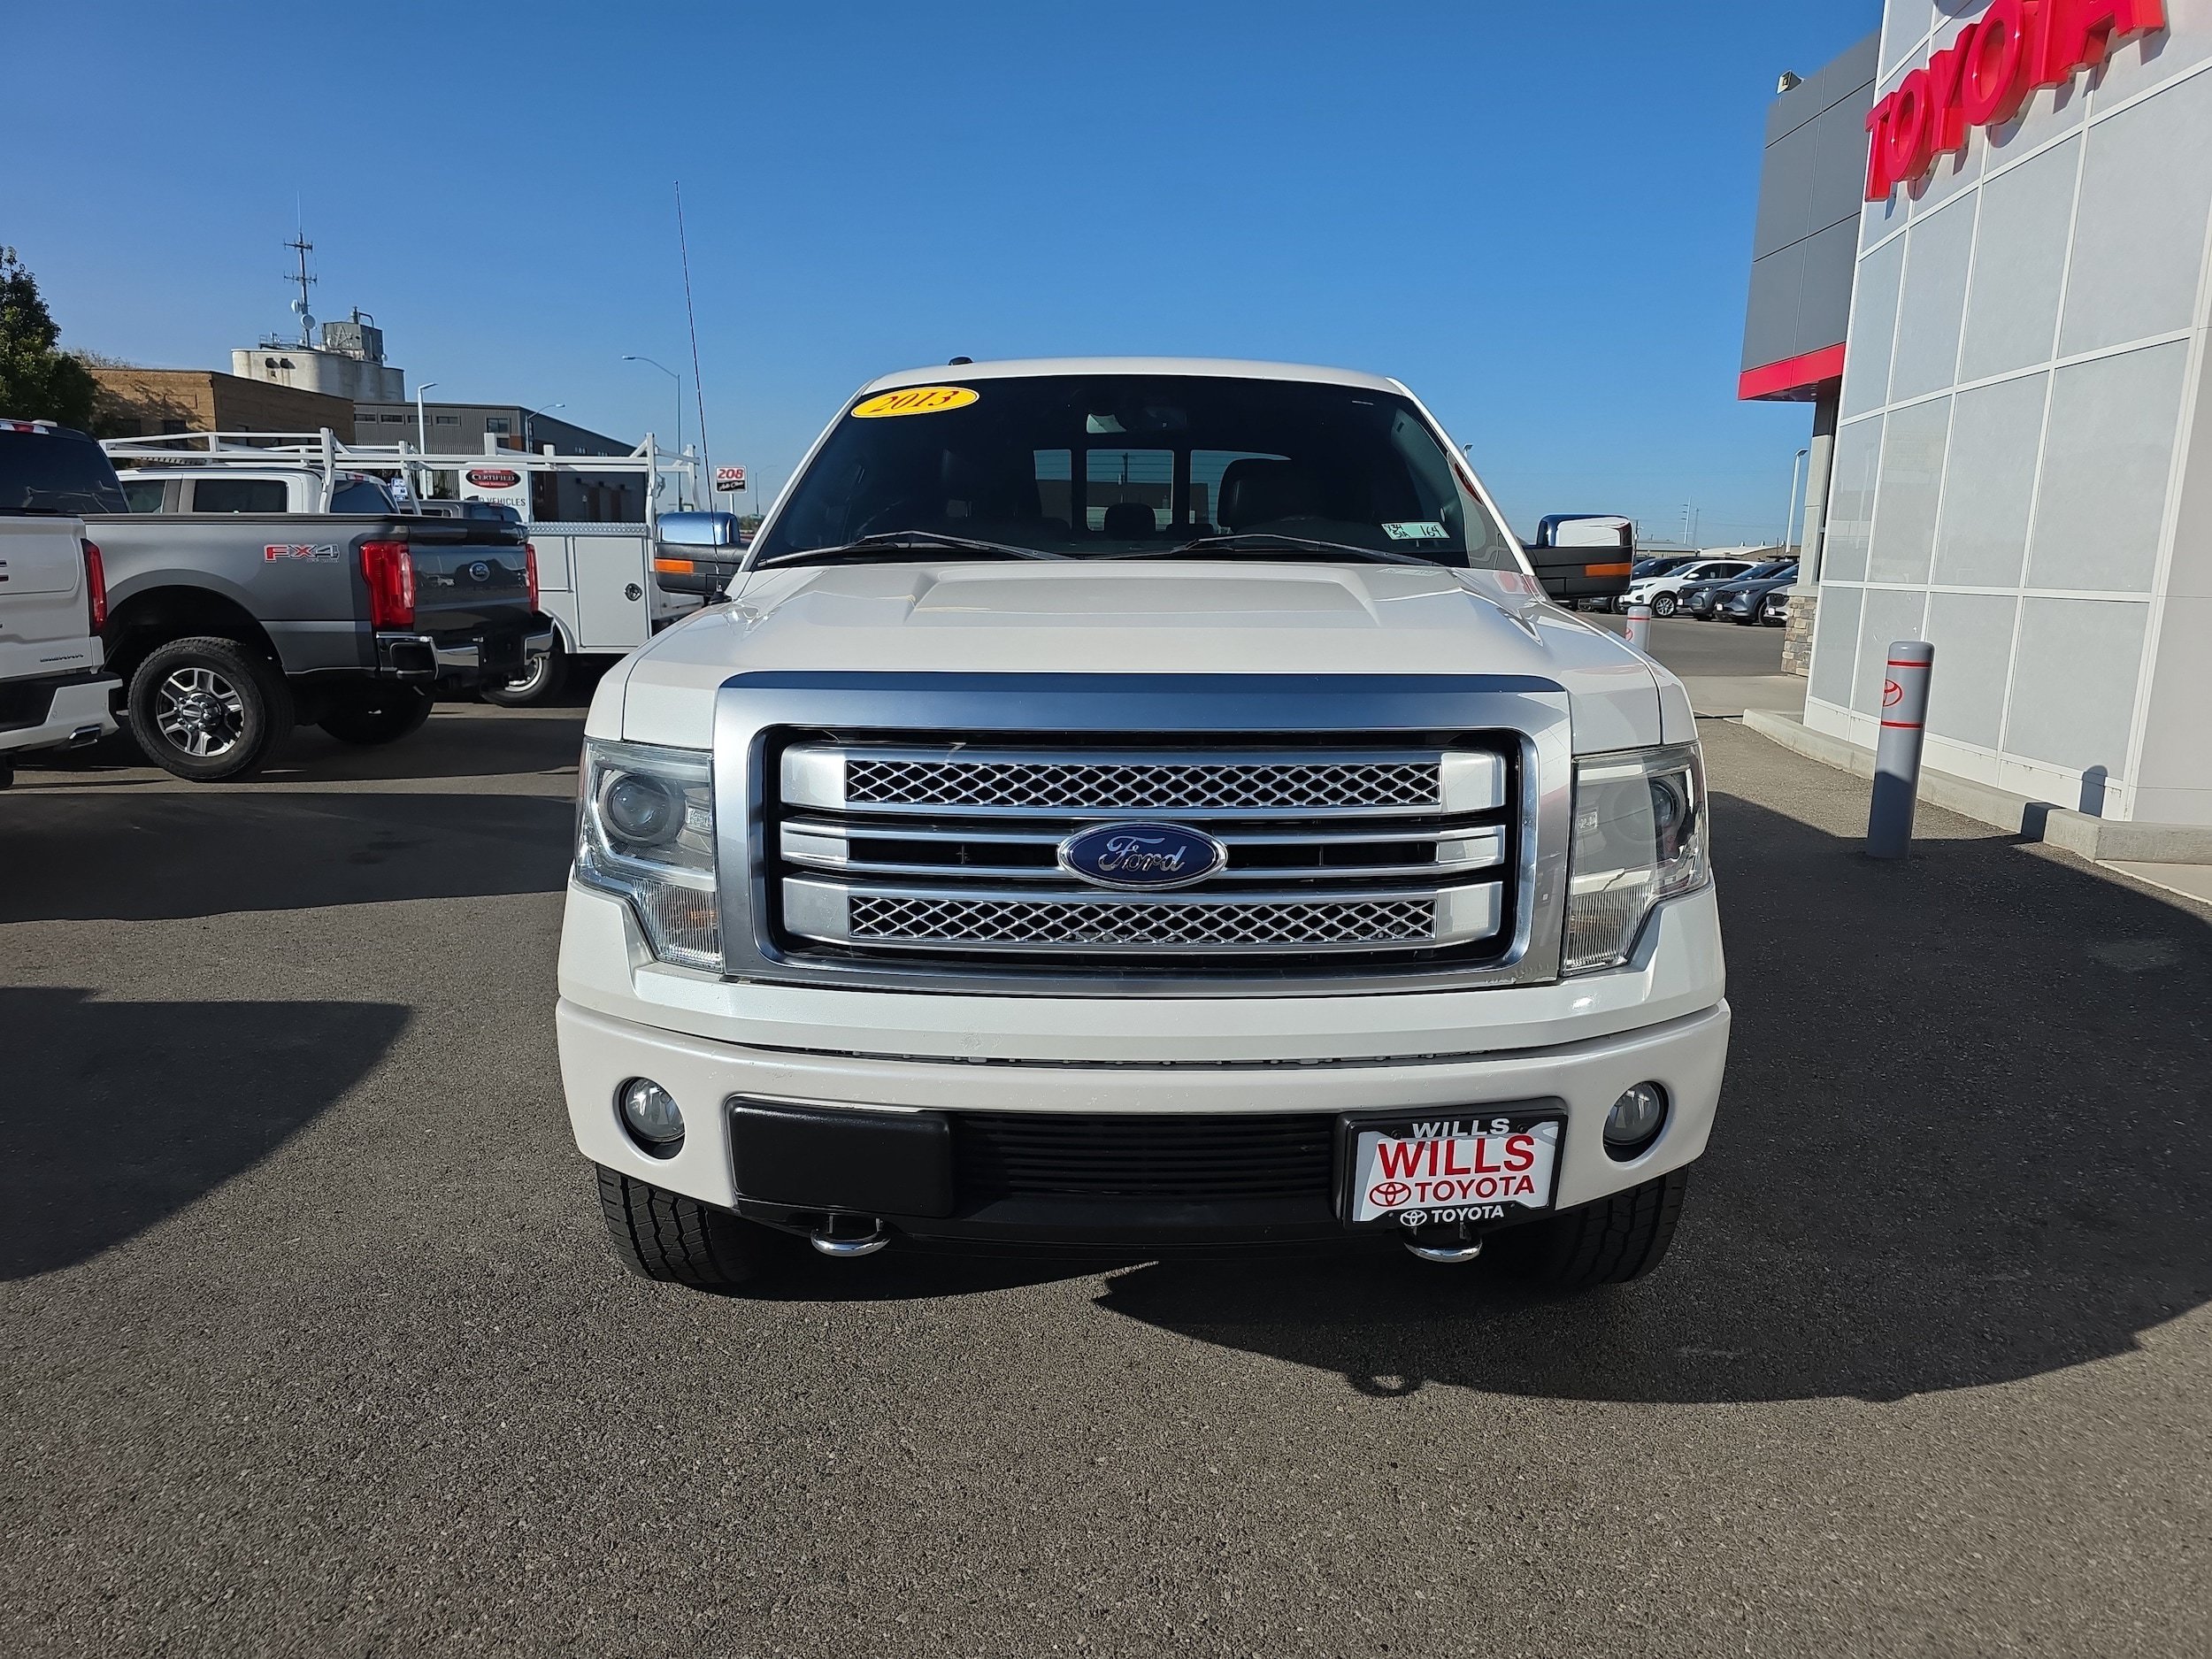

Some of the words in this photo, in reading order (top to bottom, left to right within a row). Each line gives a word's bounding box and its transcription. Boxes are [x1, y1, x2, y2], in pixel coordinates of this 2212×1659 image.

[869, 390, 960, 413] 2013
[718, 469, 744, 479] 208
[1420, 525, 1442, 537] 164
[265, 544, 340, 563] FX4
[1098, 836, 1187, 872] Ford
[1412, 1118, 1510, 1139] WILLS
[1378, 1133, 1535, 1179] WILLS
[1415, 1175, 1535, 1203] TOYOTA
[1431, 1205, 1504, 1224] TOYOTA
